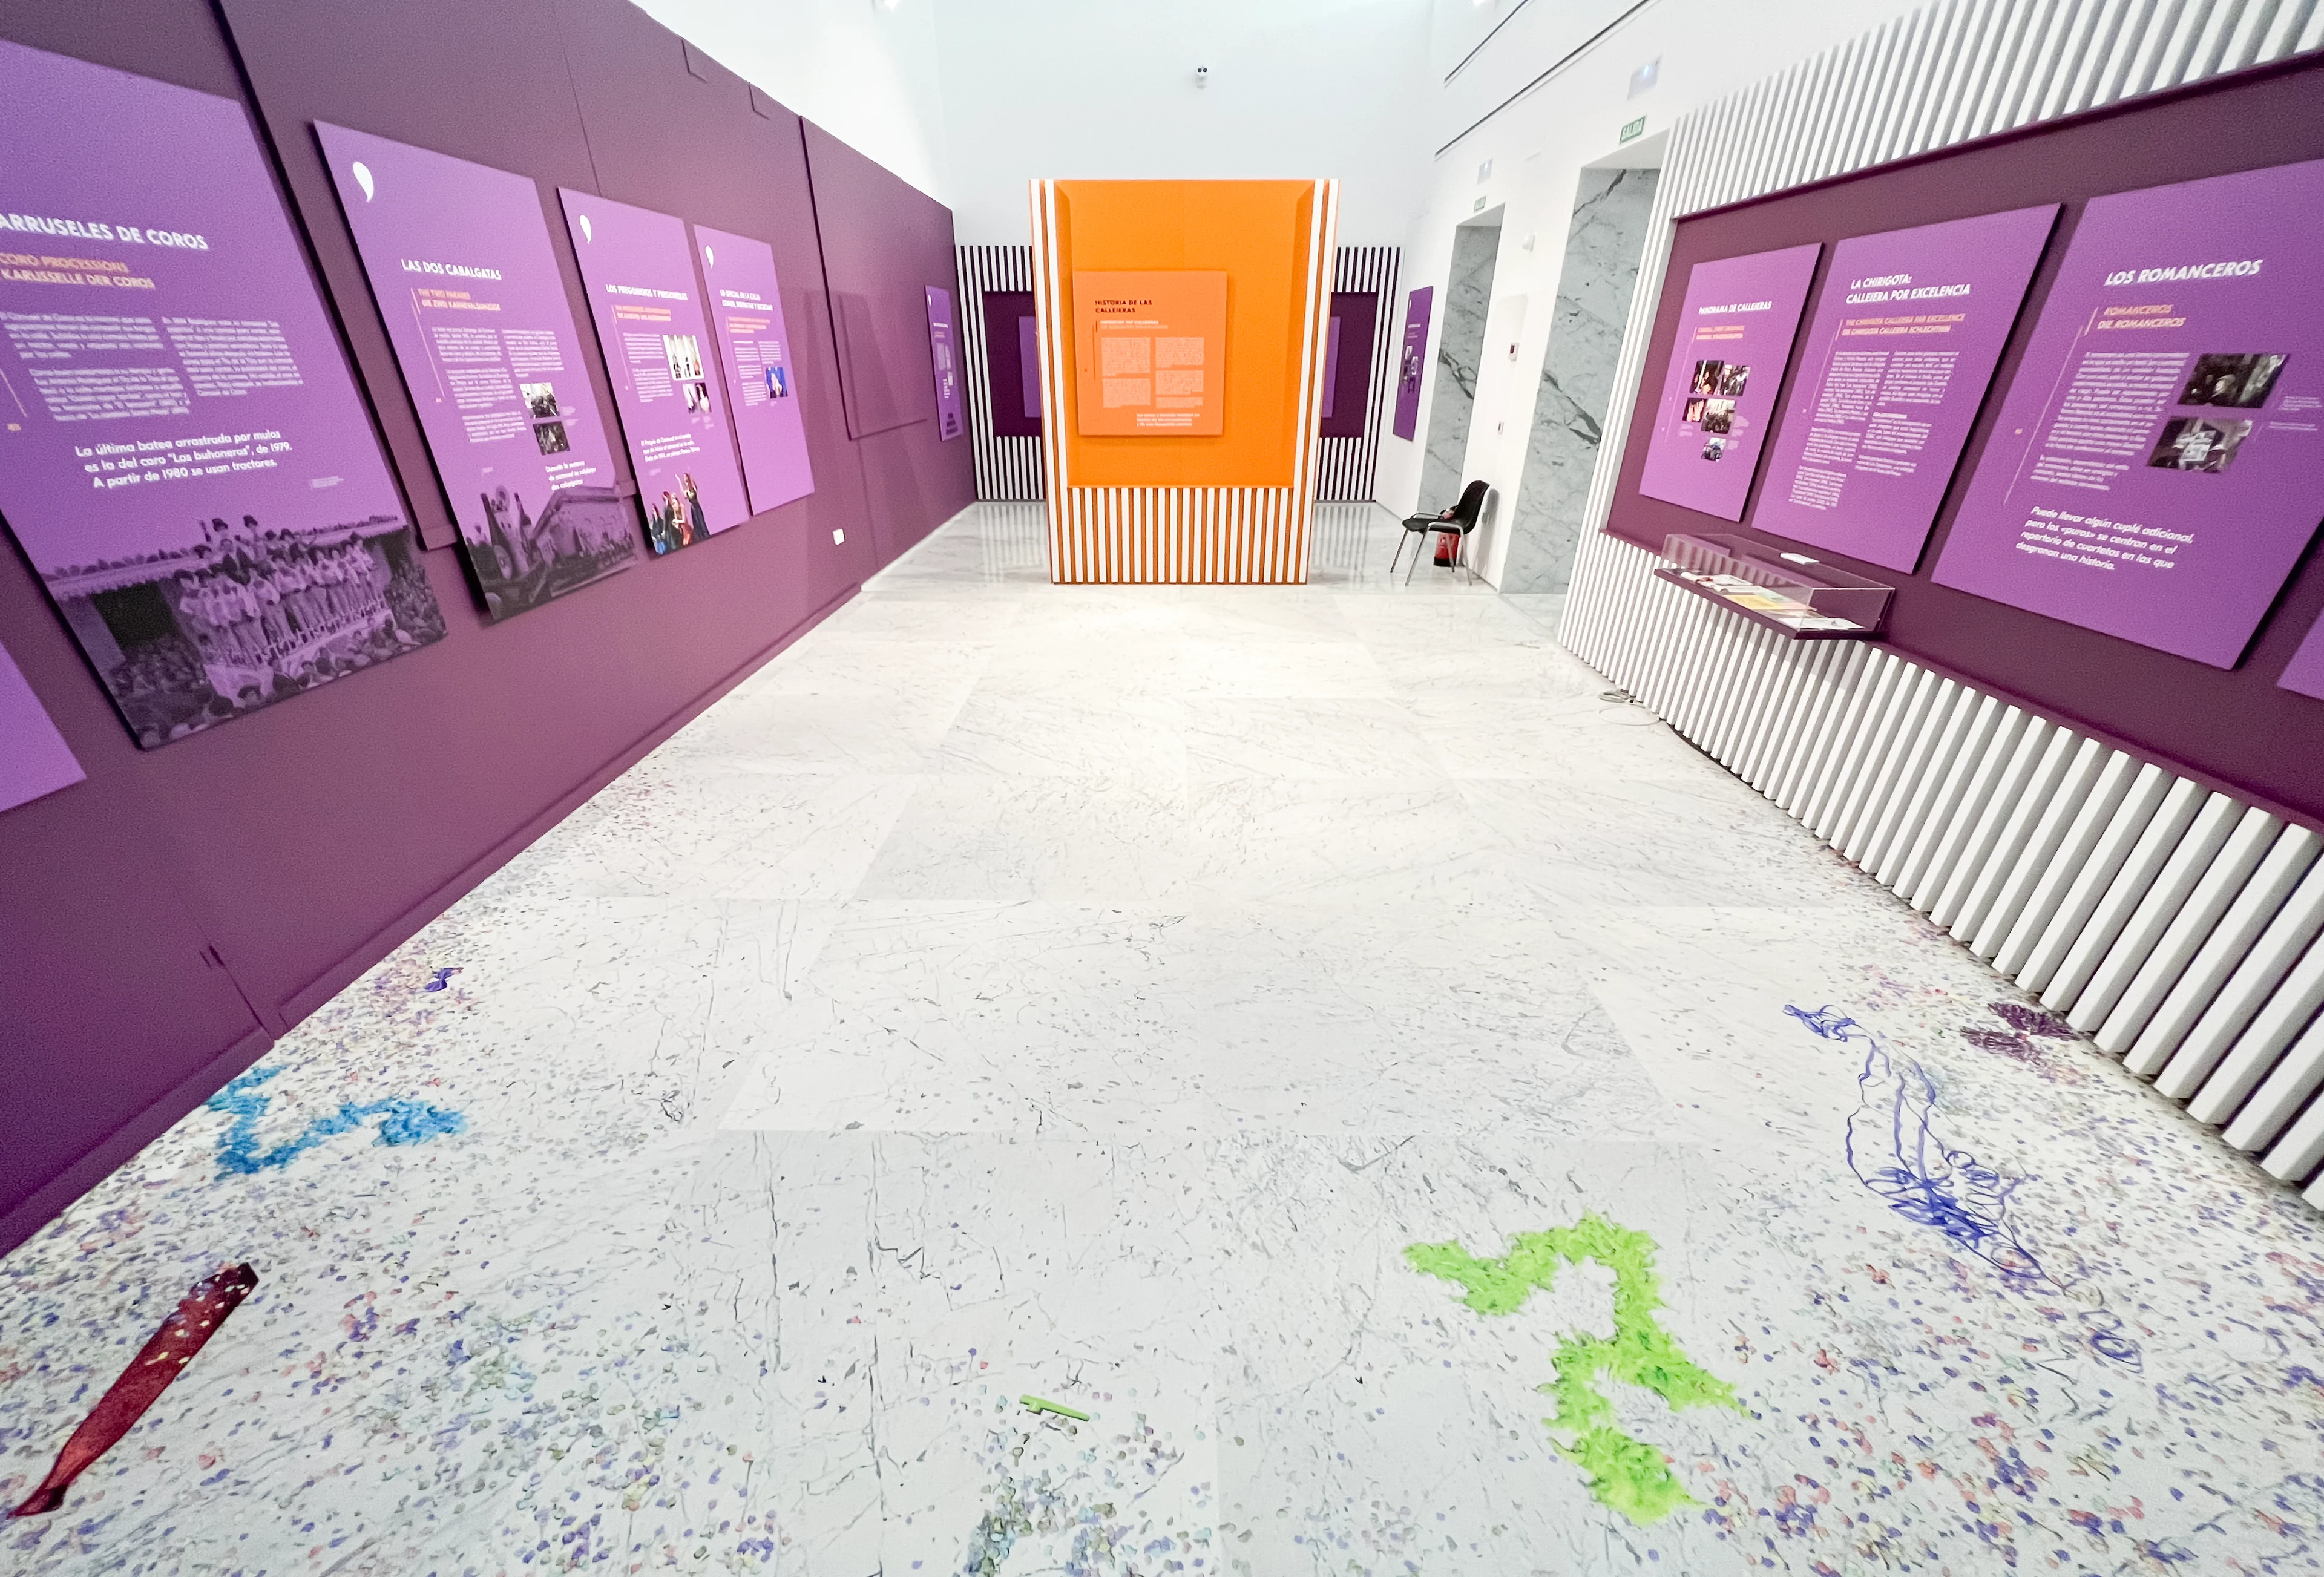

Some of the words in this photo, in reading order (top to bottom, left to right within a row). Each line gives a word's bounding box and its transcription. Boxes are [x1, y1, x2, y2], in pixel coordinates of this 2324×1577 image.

[116, 225, 146, 243] DE
[146, 229, 209, 250] COROS
[401, 258, 422, 272] LAS
[422, 261, 444, 274] DOS
[445, 263, 502, 280] CABALGATAS
[1851, 279, 1861, 289] LA
[1863, 274, 1912, 288] CHIRIGOTA:
[2104, 270, 2136, 286] LOS
[2136, 260, 2264, 284] ROMANCEROS
[113, 276, 156, 289] COROS
[605, 284, 618, 293] LOS
[1846, 291, 1889, 304] CALLEJERA
[1889, 289, 1910, 300] POR
[1910, 283, 1971, 300] EXCELENCIA
[1728, 304, 1738, 312] DE
[2103, 304, 2175, 316] ROMANCEROS
[2097, 320, 2115, 329] DIE
[2114, 318, 2187, 329] ROMANCEROS
[75, 446, 93, 457] La
[95, 443, 135, 455] última
[137, 441, 173, 451] batea
[175, 433, 232, 447] arrastrada
[234, 433, 251, 444] por
[253, 429, 281, 440] mulas
[84, 464, 100, 473] es
[100, 459, 115, 470] la
[118, 456, 138, 469] del
[256, 444, 269, 454] de
[270, 442, 293, 453] 1979.
[93, 477, 105, 488] A
[107, 473, 141, 489] partir
[144, 471, 160, 481] de
[162, 467, 188, 480] 1980
[191, 467, 203, 476] se
[205, 464, 230, 474] usan
[232, 459, 278, 471] tractores.
[2024, 519, 2046, 528] pero
[2046, 521, 2060, 532] los
[2096, 533, 2109, 541] se
[2109, 536, 2148, 548] centran
[2148, 543, 2164, 552] en
[2164, 545, 2179, 554] el
[2030, 505, 2058, 518] Puede
[2058, 511, 2085, 523] llevar
[2084, 516, 2112, 528] algún
[2113, 522, 2143, 534] cuplé
[2142, 527, 2195, 544] adicional,
[2015, 541, 2060, 557] desgranan
[2060, 552, 2078, 562] una
[2078, 555, 2116, 571] historia.
[2020, 530, 2063, 545] repertorio
[2063, 538, 2076, 548] de
[2121, 551, 2136, 560] en
[2135, 553, 2153, 564] las
[2153, 559, 2175, 569] que
